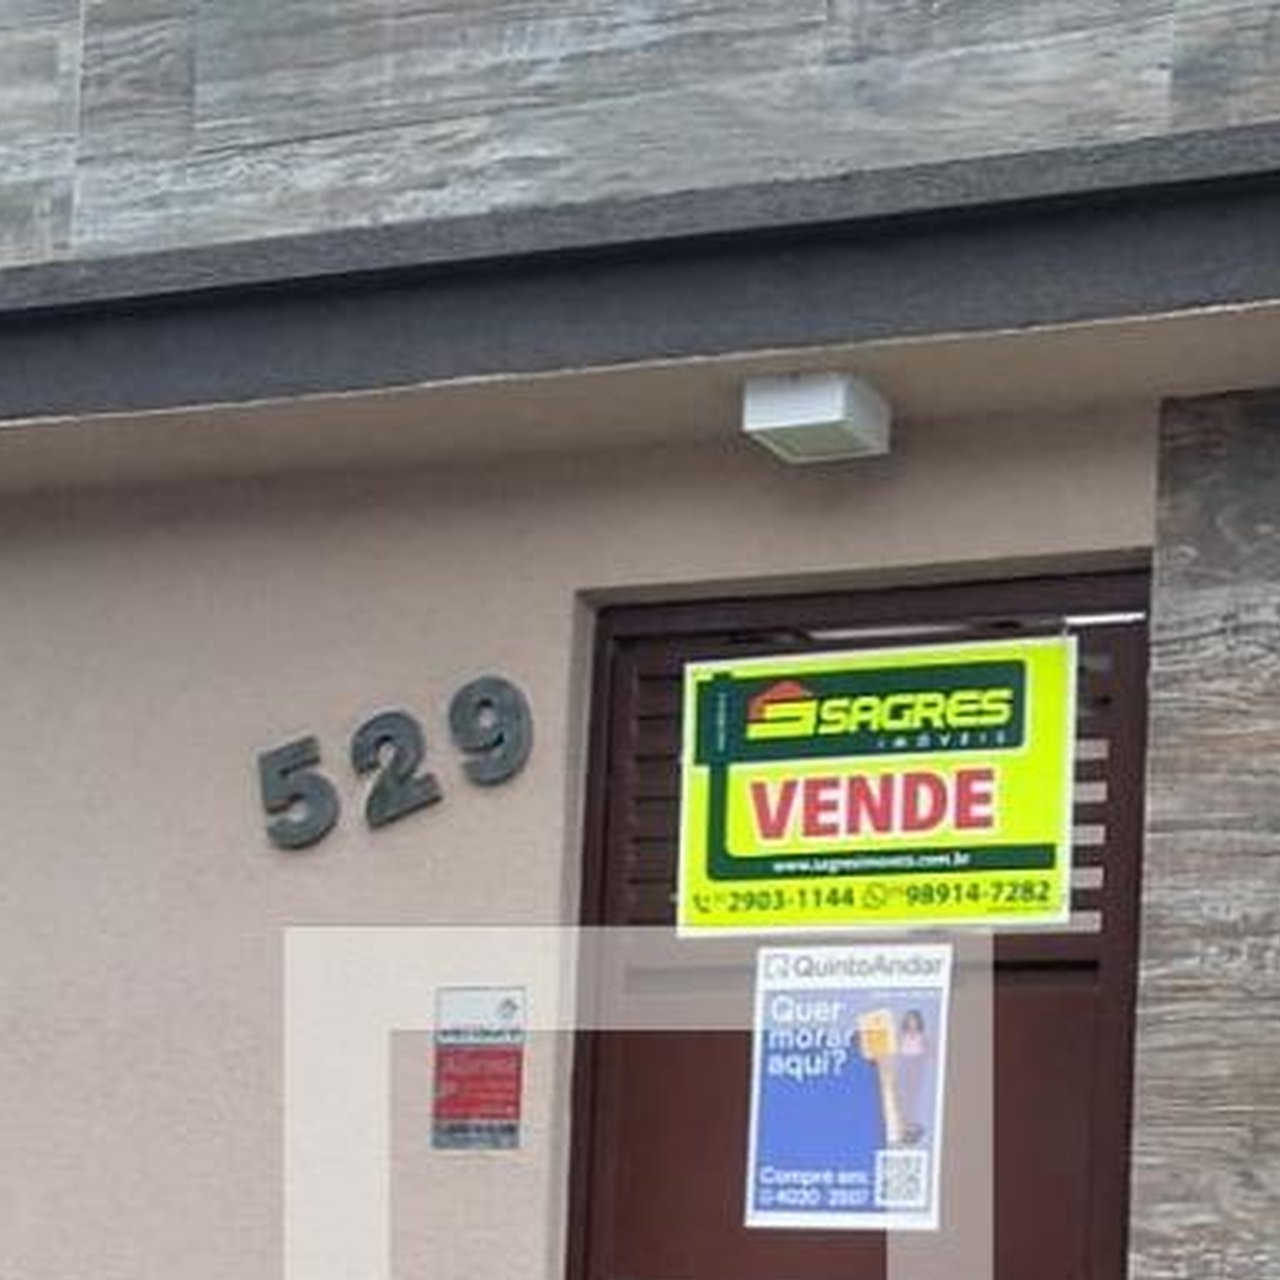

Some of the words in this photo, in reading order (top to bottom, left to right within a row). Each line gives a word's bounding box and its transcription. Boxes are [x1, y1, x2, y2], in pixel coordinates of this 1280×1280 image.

[819, 689, 1015, 735] SAGRES
[258, 676, 533, 850] 529
[750, 768, 996, 840] VENDE
[728, 888, 855, 912] 2903-1144
[792, 953, 942, 978] QuintoAndar
[771, 994, 846, 1023] Quer
[768, 1029, 853, 1049] morar
[768, 1050, 848, 1080] aqui?
